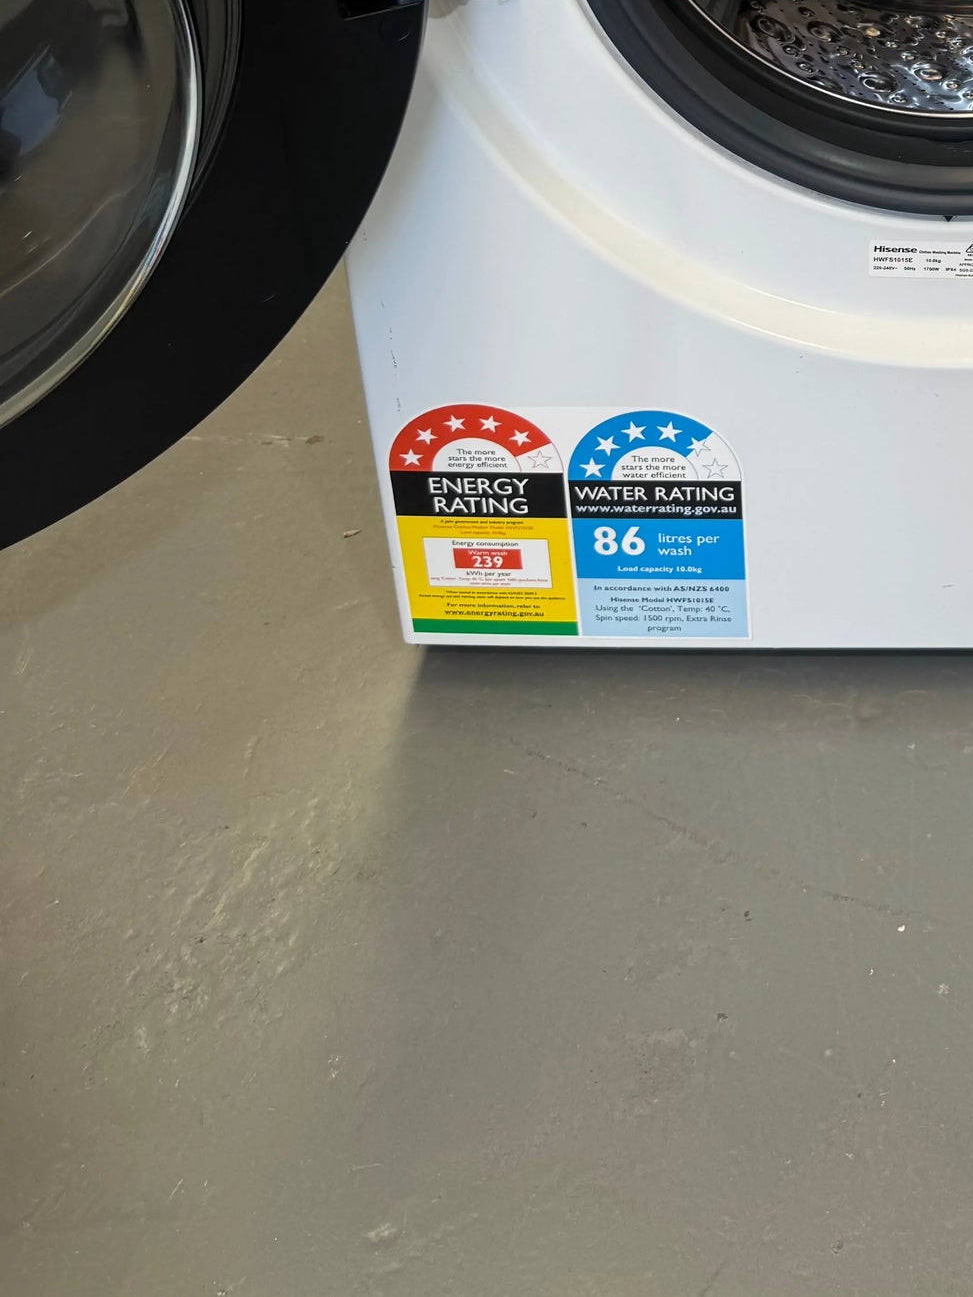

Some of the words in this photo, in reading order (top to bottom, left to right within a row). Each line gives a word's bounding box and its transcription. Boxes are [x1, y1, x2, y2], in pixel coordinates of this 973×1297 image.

[873, 245, 918, 253] Hisense
[456, 448, 472, 456] The
[631, 455, 649, 463] The
[650, 471, 687, 479] efficient
[428, 477, 529, 495] ENERGY
[574, 486, 648, 501] WATER
[654, 486, 735, 501] RATING
[433, 497, 529, 514] RATING
[575, 503, 737, 515] www.waterrating.gov.au
[451, 540, 475, 548] Energy
[593, 526, 646, 556] 86
[658, 533, 692, 544] litres
[696, 535, 720, 546] per
[657, 546, 692, 556] wash
[472, 555, 504, 568] 239
[640, 565, 674, 574] capacity
[676, 565, 703, 574] 10.0kg
[444, 609, 545, 618] www.energyrating.gov.au
[595, 605, 618, 613] Using
[677, 605, 703, 613] Temp:
[595, 614, 613, 622] Spin
[615, 614, 641, 622] speed:
[643, 614, 663, 622] 1500
[647, 625, 682, 633] program
